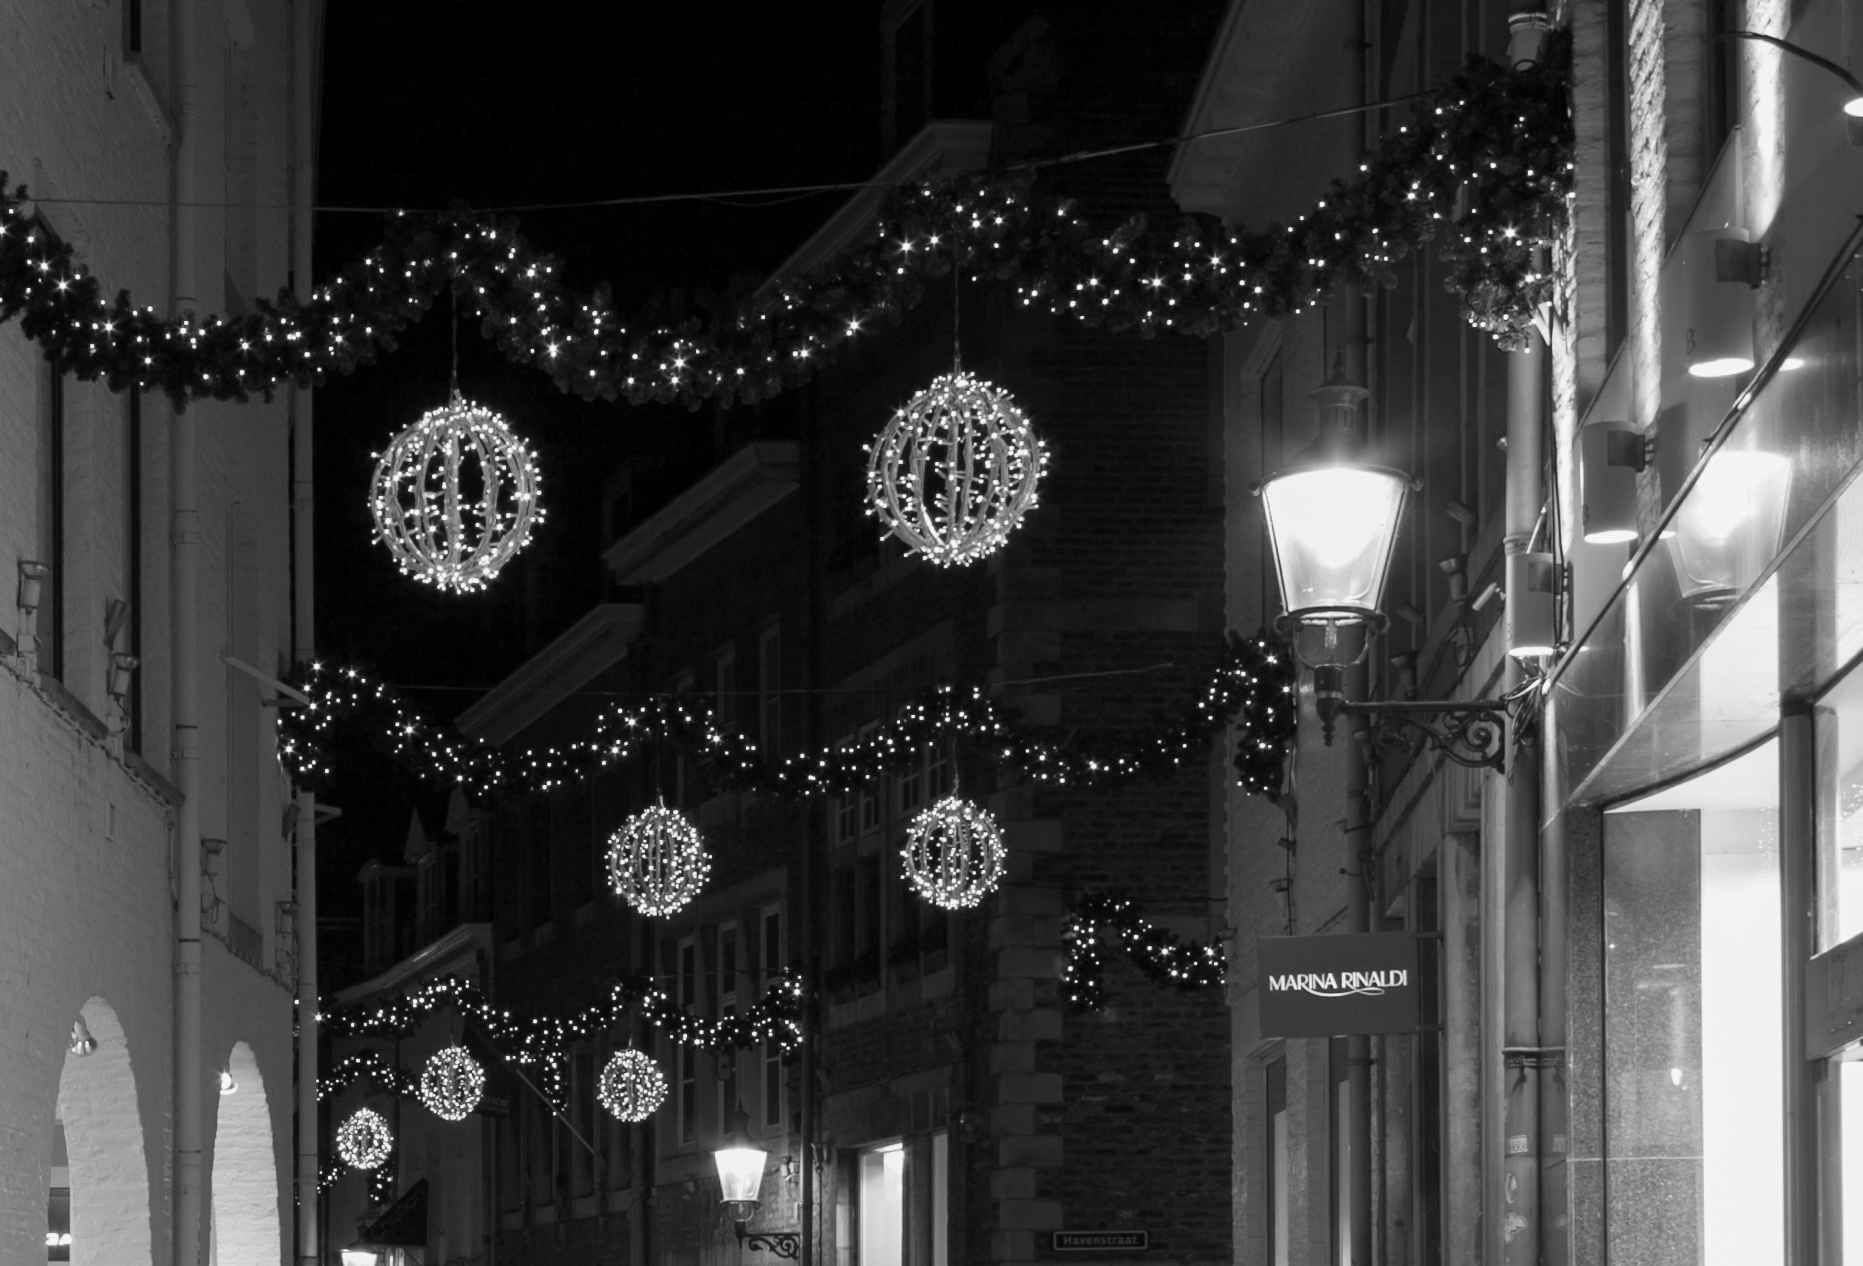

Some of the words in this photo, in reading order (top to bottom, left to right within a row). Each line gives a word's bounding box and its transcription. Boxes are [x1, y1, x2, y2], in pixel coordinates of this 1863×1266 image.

[1268, 972, 1338, 992] MARINA
[1341, 969, 1408, 990] RINALDI
[1063, 1235, 1138, 1246] Havenstraat
